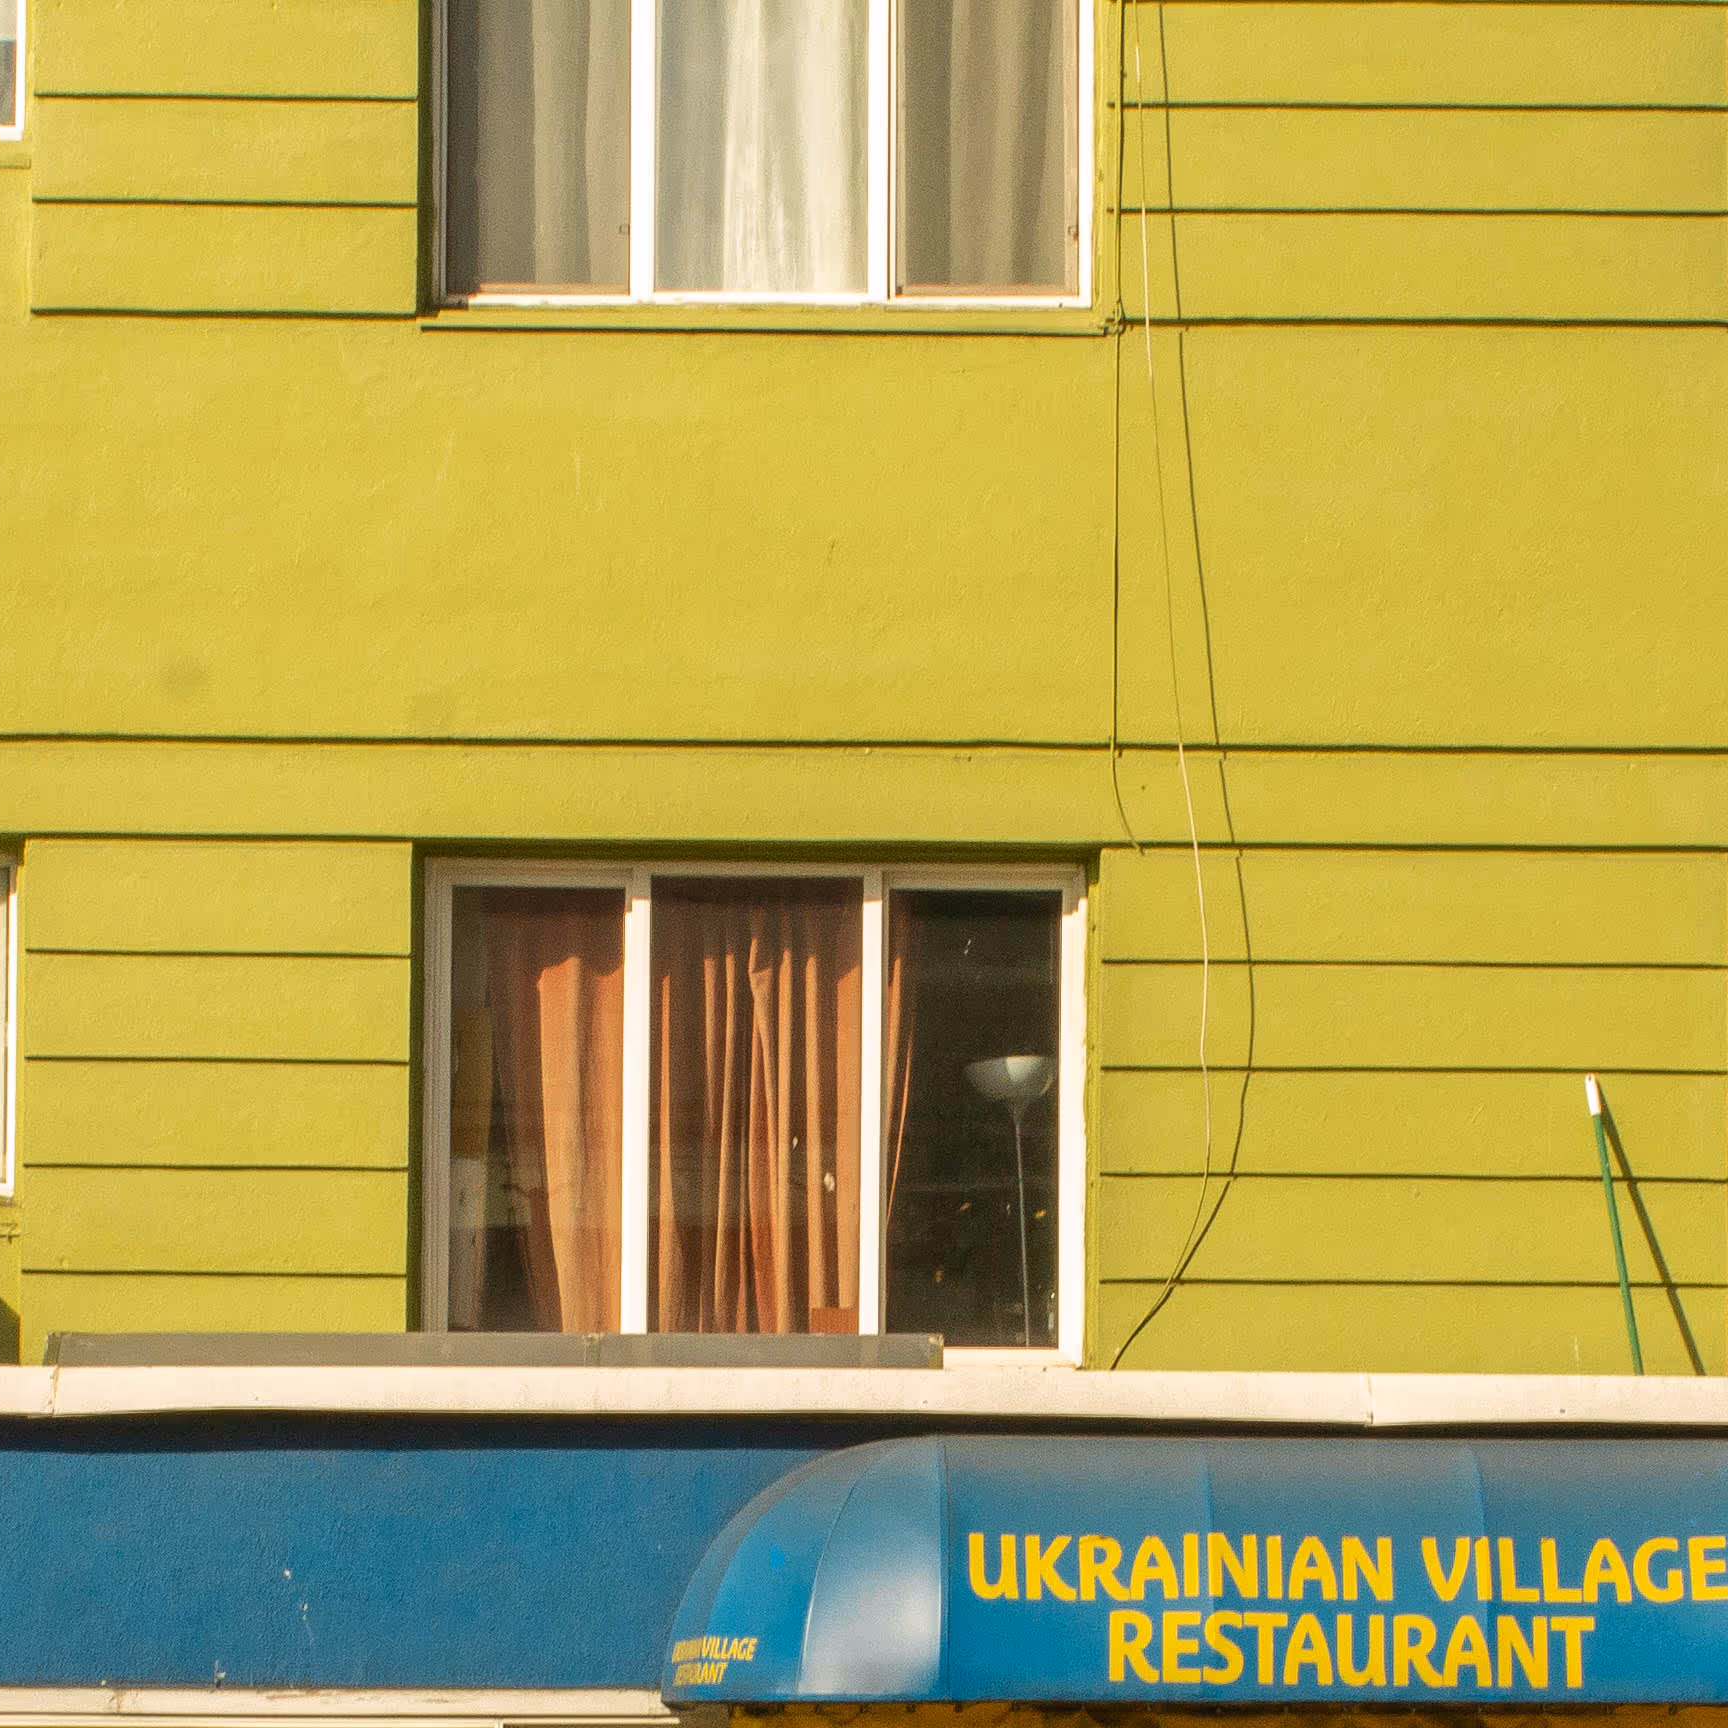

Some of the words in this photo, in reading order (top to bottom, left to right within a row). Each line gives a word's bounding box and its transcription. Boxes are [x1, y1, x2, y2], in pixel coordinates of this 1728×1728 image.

[968, 1533, 1393, 1602] UKRAINIAN
[702, 1635, 758, 1661] VILLAGE
[1109, 1610, 1594, 1689] RESTAURANT
